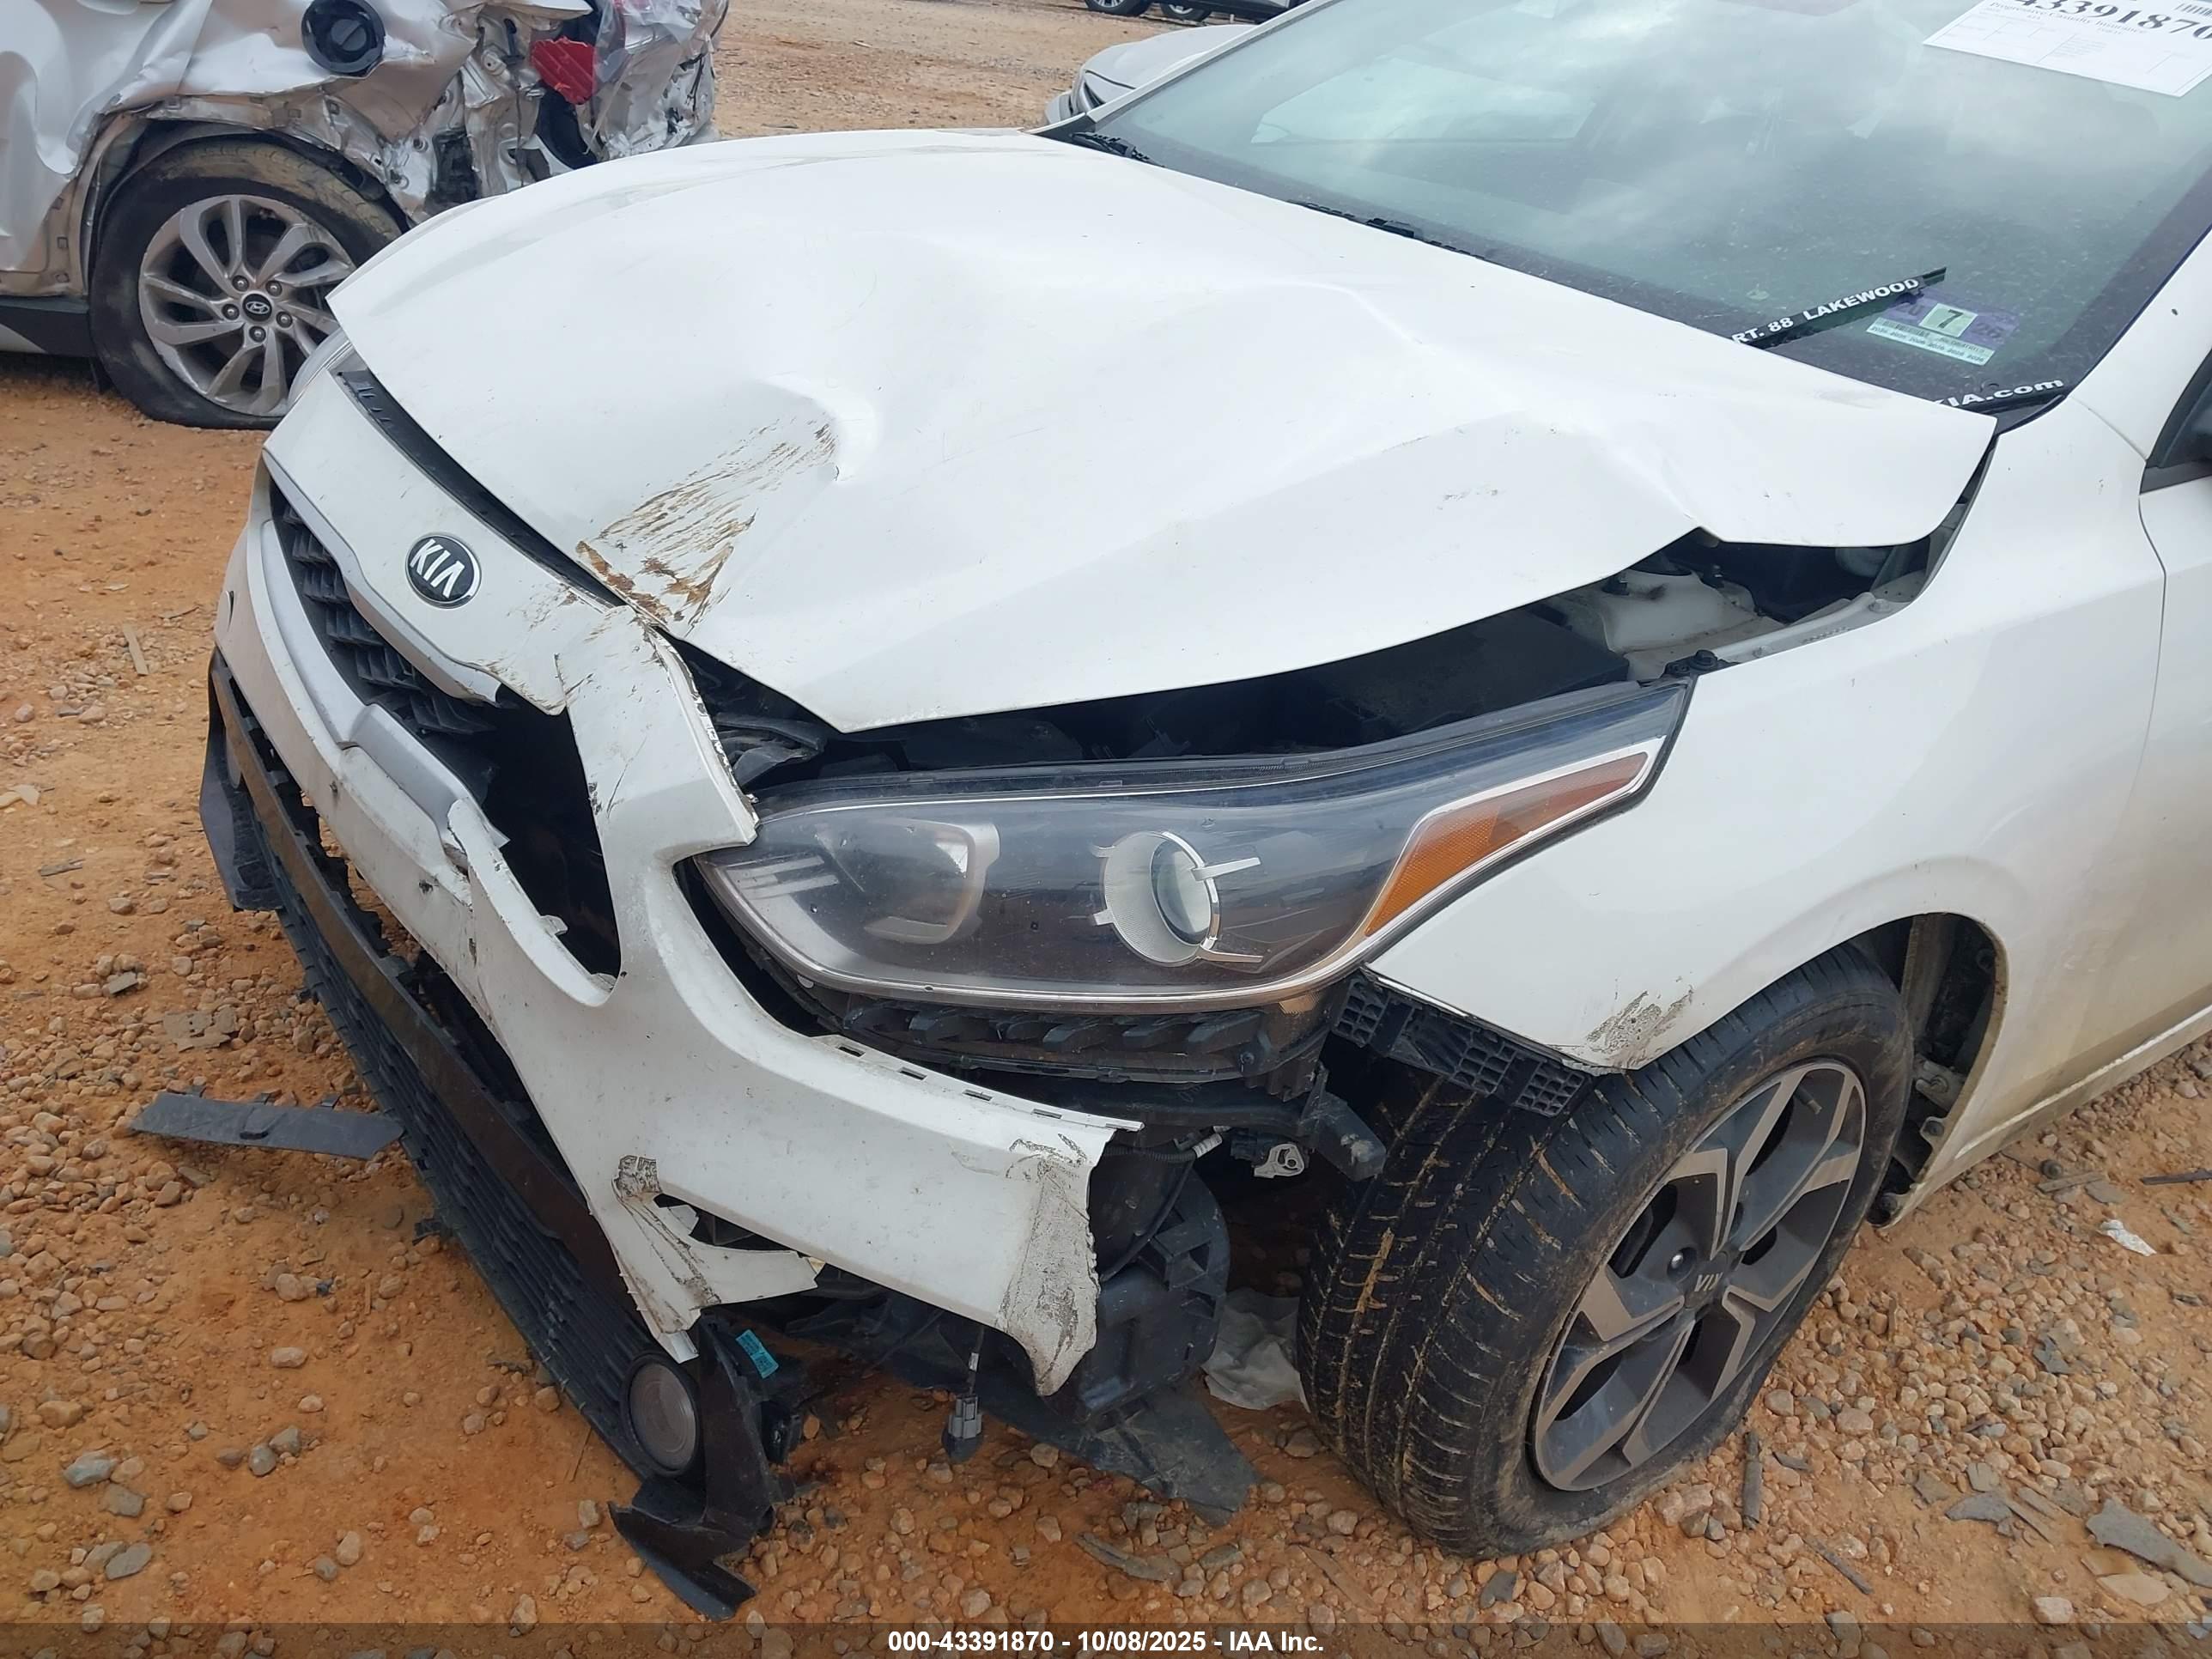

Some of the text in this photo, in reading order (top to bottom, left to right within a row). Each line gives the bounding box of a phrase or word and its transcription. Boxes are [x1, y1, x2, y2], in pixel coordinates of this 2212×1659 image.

[1767, 317, 1794, 333] 88
[1802, 278, 1919, 321] LAKEWOOD
[1937, 309, 1964, 329] 7
[410, 538, 465, 599] KIA
